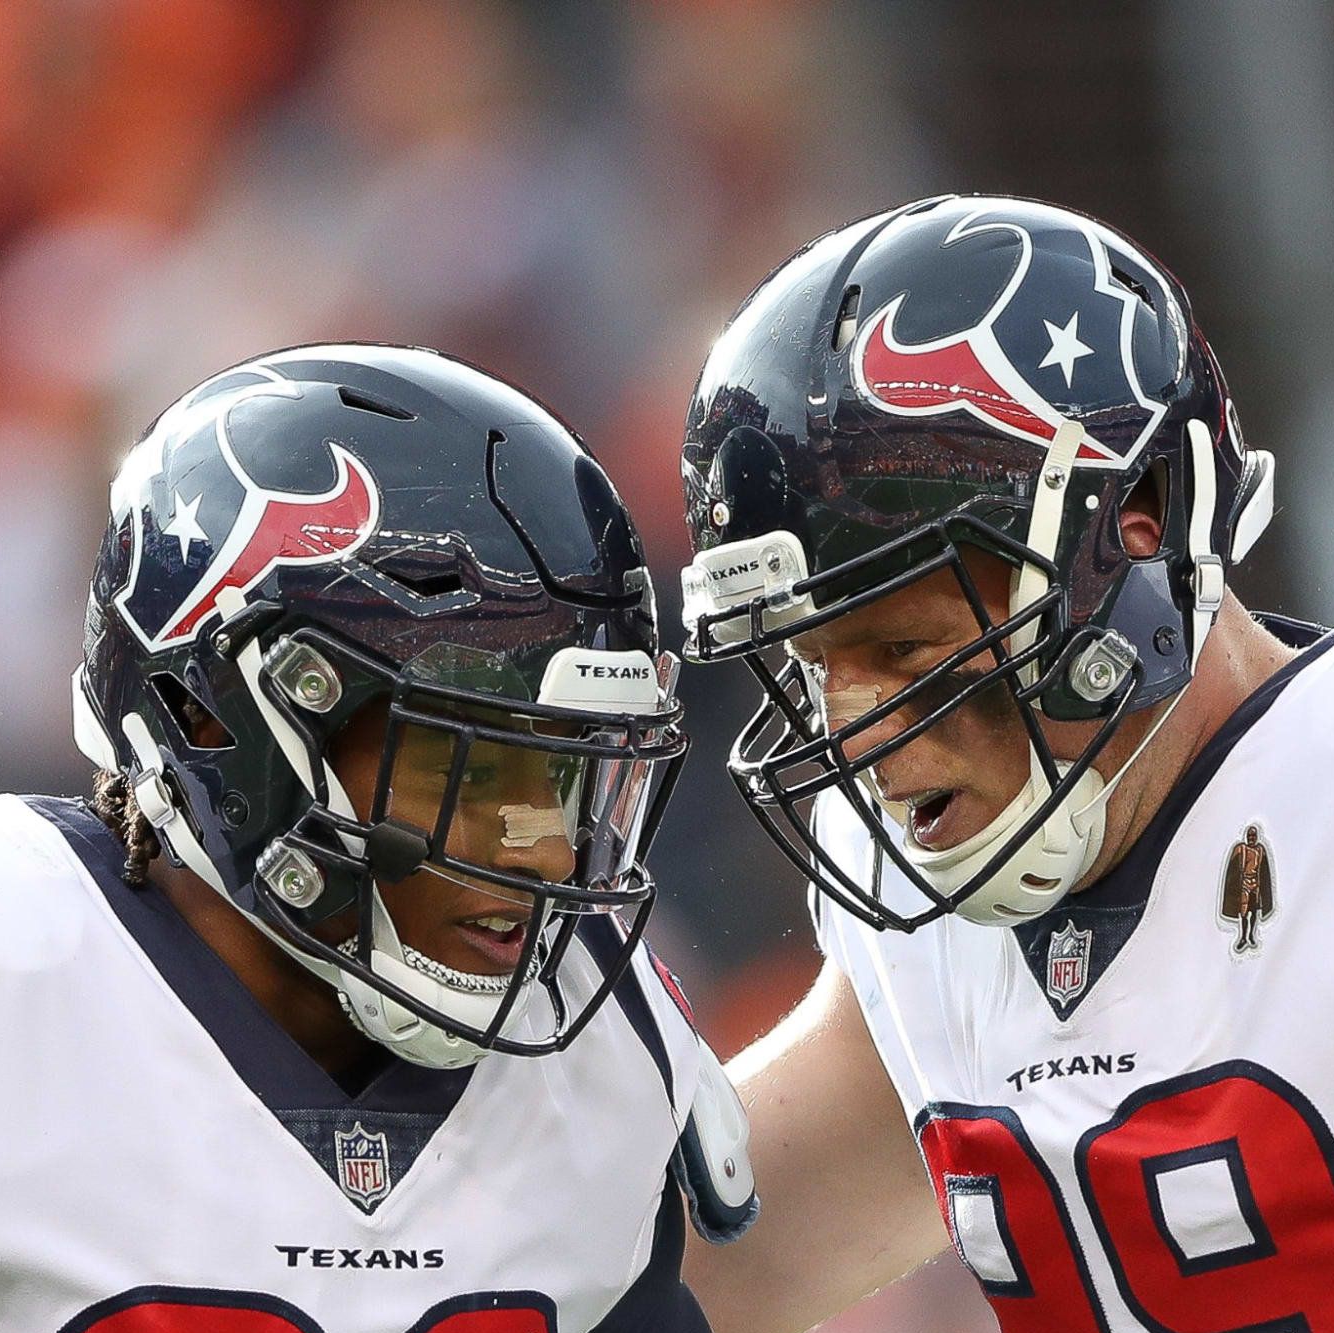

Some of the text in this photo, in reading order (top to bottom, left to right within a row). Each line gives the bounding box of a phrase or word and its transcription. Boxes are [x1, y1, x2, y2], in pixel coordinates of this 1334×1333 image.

[710, 560, 760, 581] EXANS
[575, 664, 649, 680] TEXANS
[1053, 960, 1080, 990] NFL
[1006, 1052, 1137, 1092] TEXANS
[346, 1160, 383, 1192] NFL
[274, 1245, 444, 1269] TEXANS
